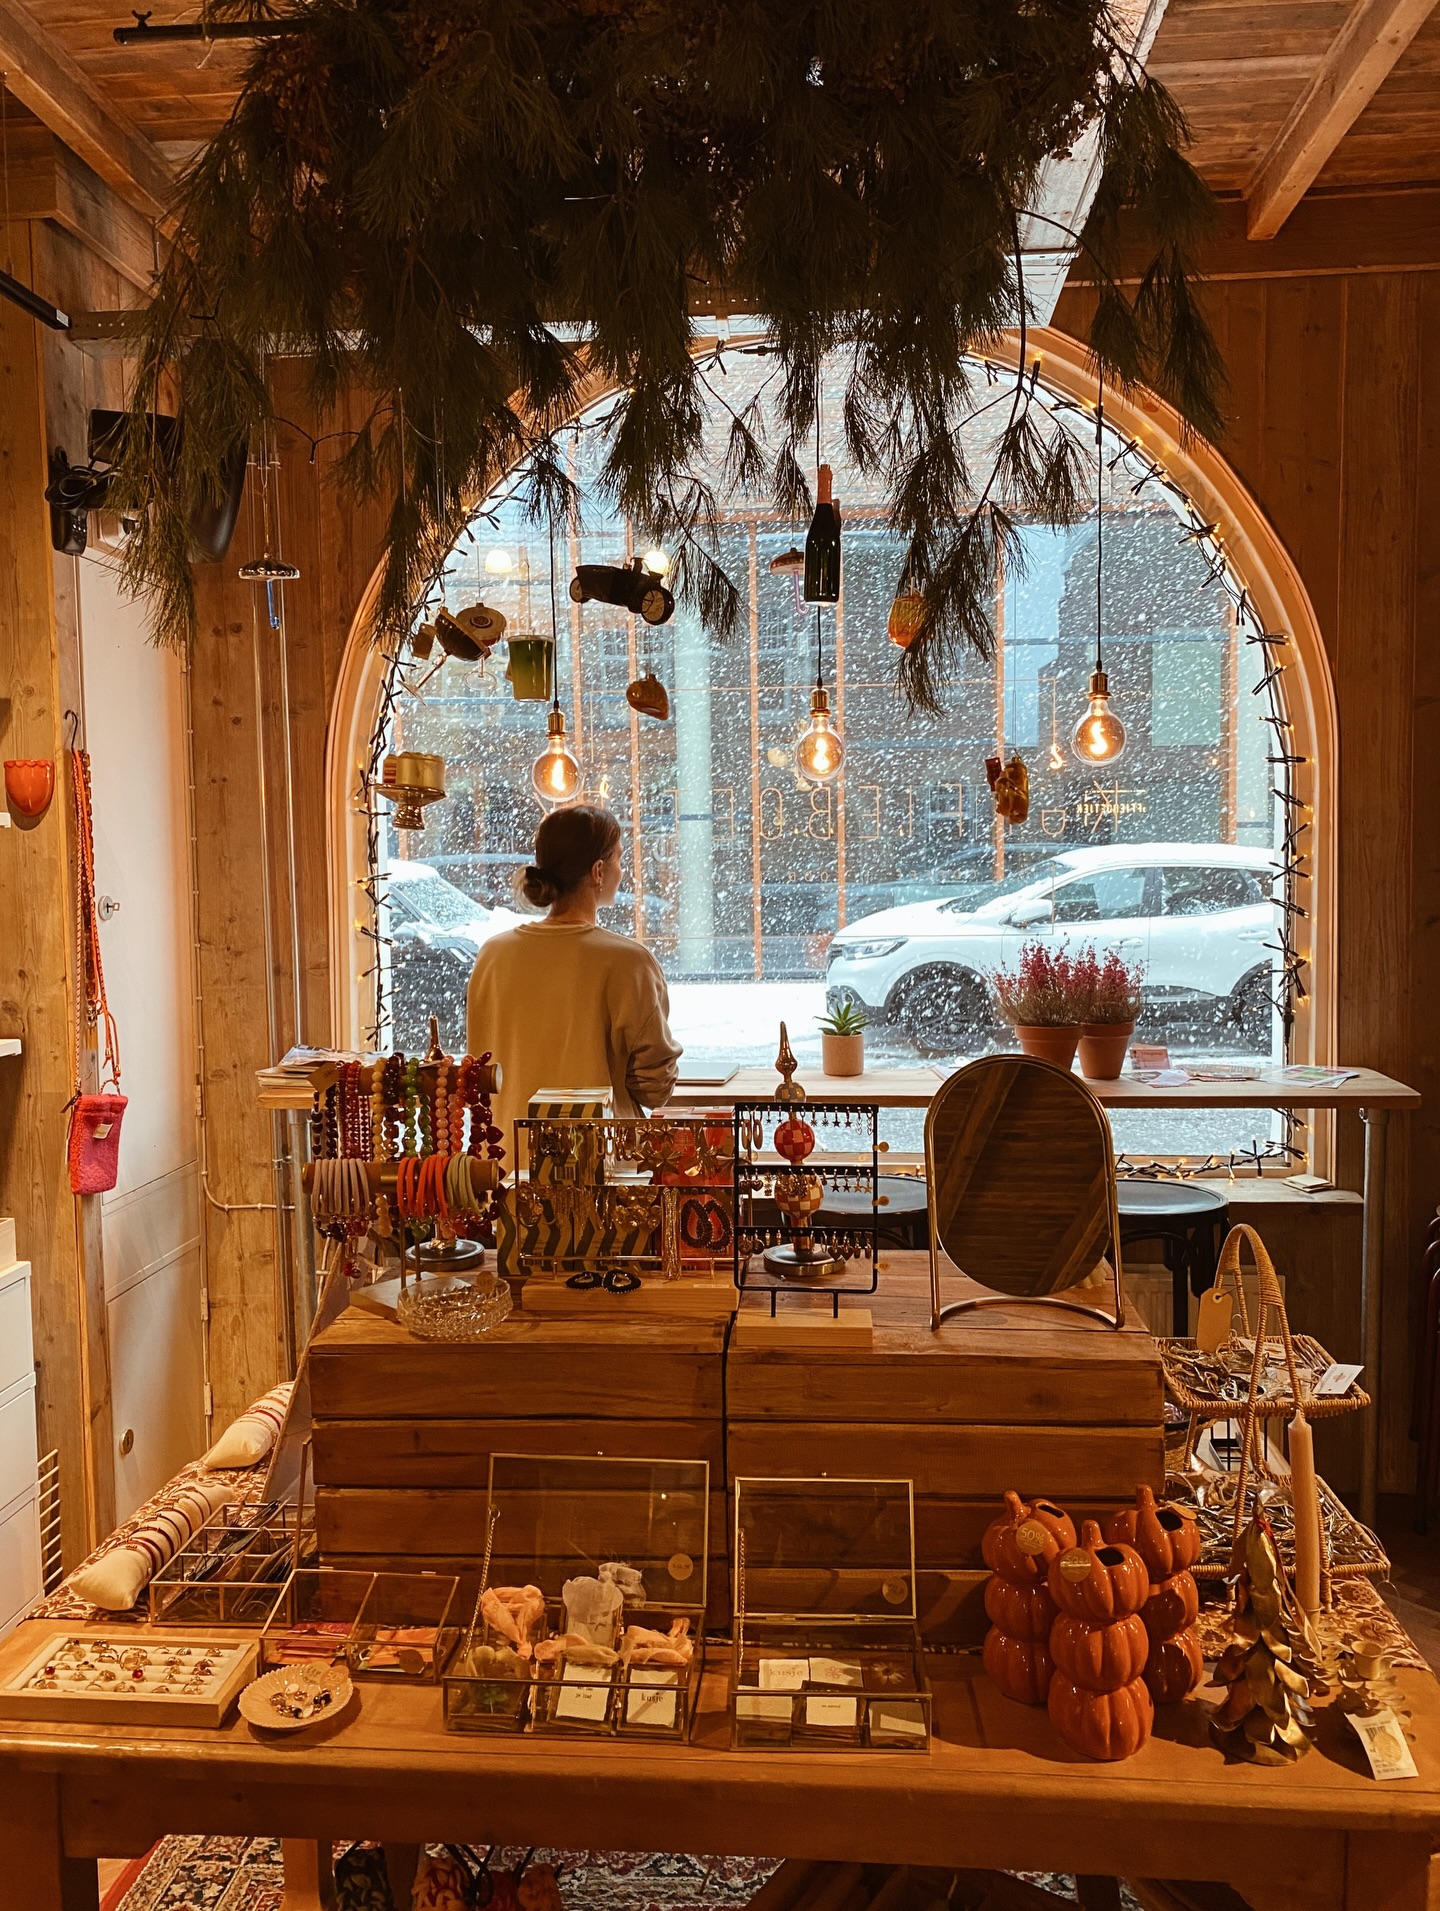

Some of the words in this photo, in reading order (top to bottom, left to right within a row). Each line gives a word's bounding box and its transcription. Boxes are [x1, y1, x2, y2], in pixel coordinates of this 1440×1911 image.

[1020, 1527, 1045, 1544] 50%
[769, 1666, 803, 1678] kusje
[641, 1692, 664, 1704] kusje
